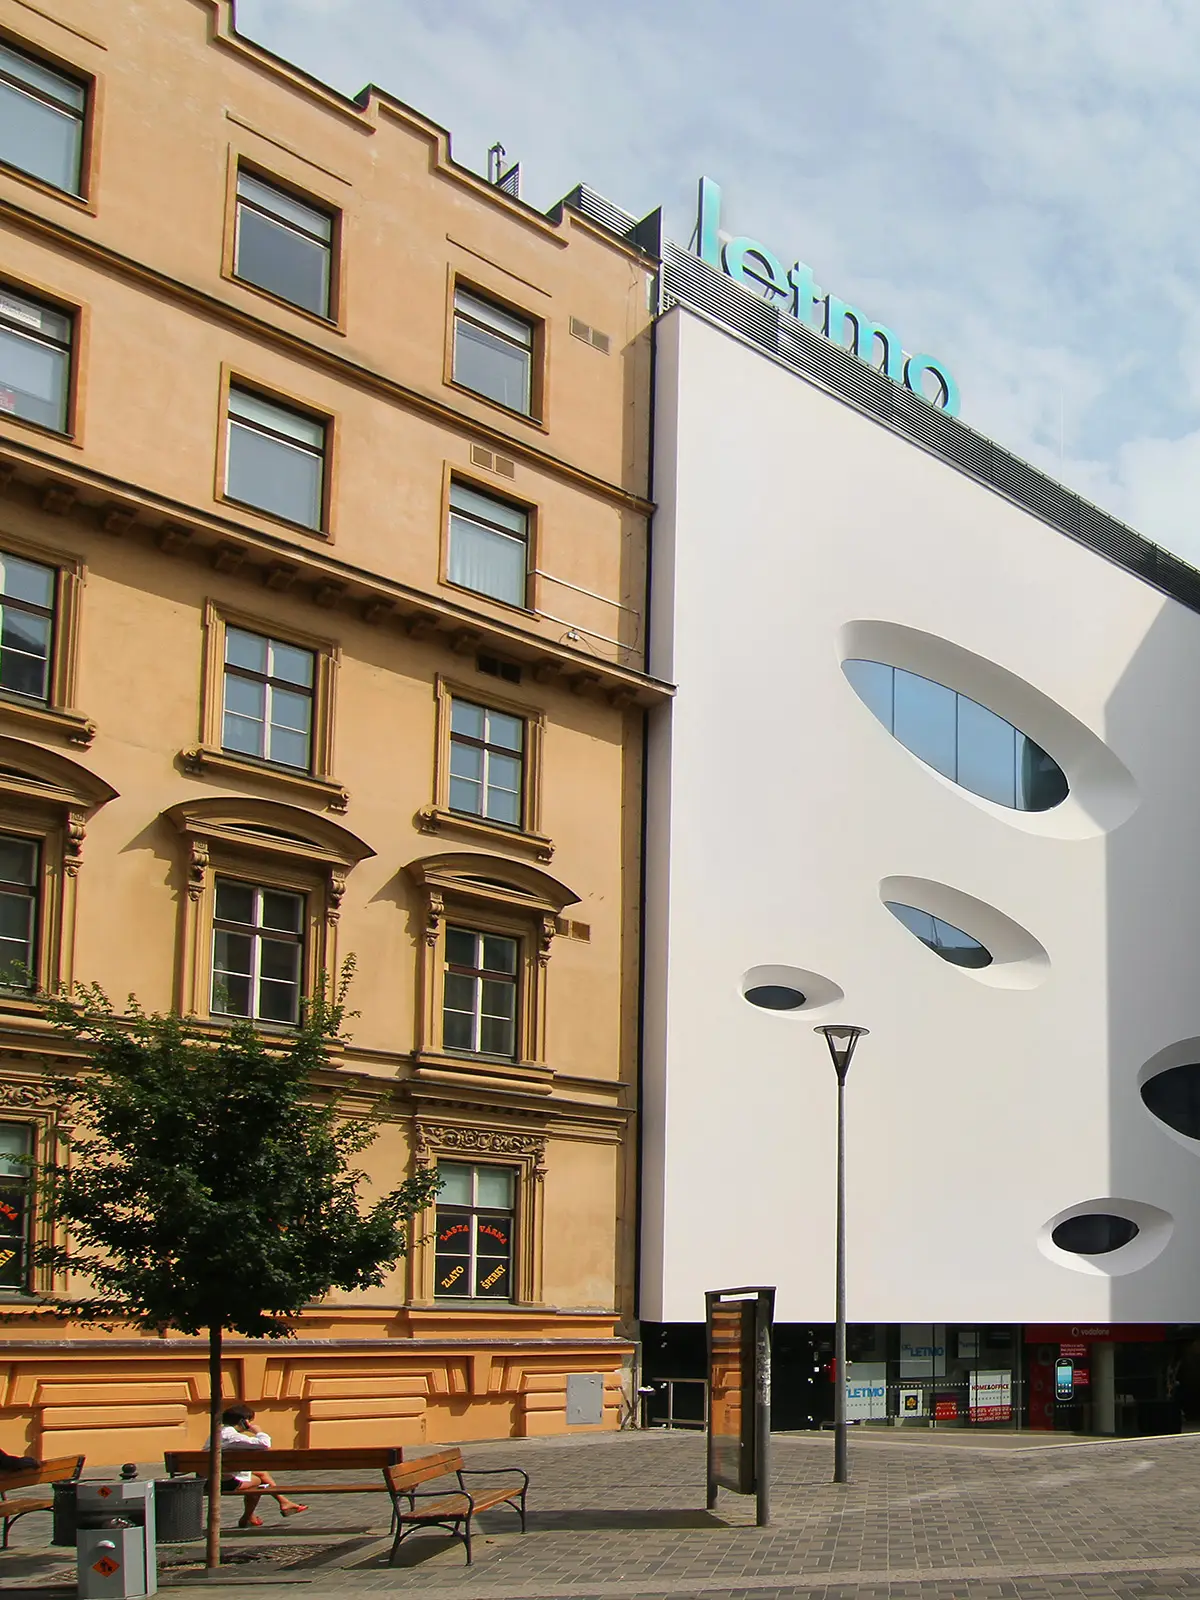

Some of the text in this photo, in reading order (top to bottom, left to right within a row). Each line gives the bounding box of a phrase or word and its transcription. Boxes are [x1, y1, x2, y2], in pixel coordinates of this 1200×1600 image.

[696, 175, 961, 418] letmo
[441, 1265, 465, 1289] ZLATO
[480, 1264, 506, 1290] ŠPERKY
[1080, 1328, 1110, 1336] vodafone
[910, 1346, 944, 1357] LETMO
[847, 1386, 885, 1399] LETMO
